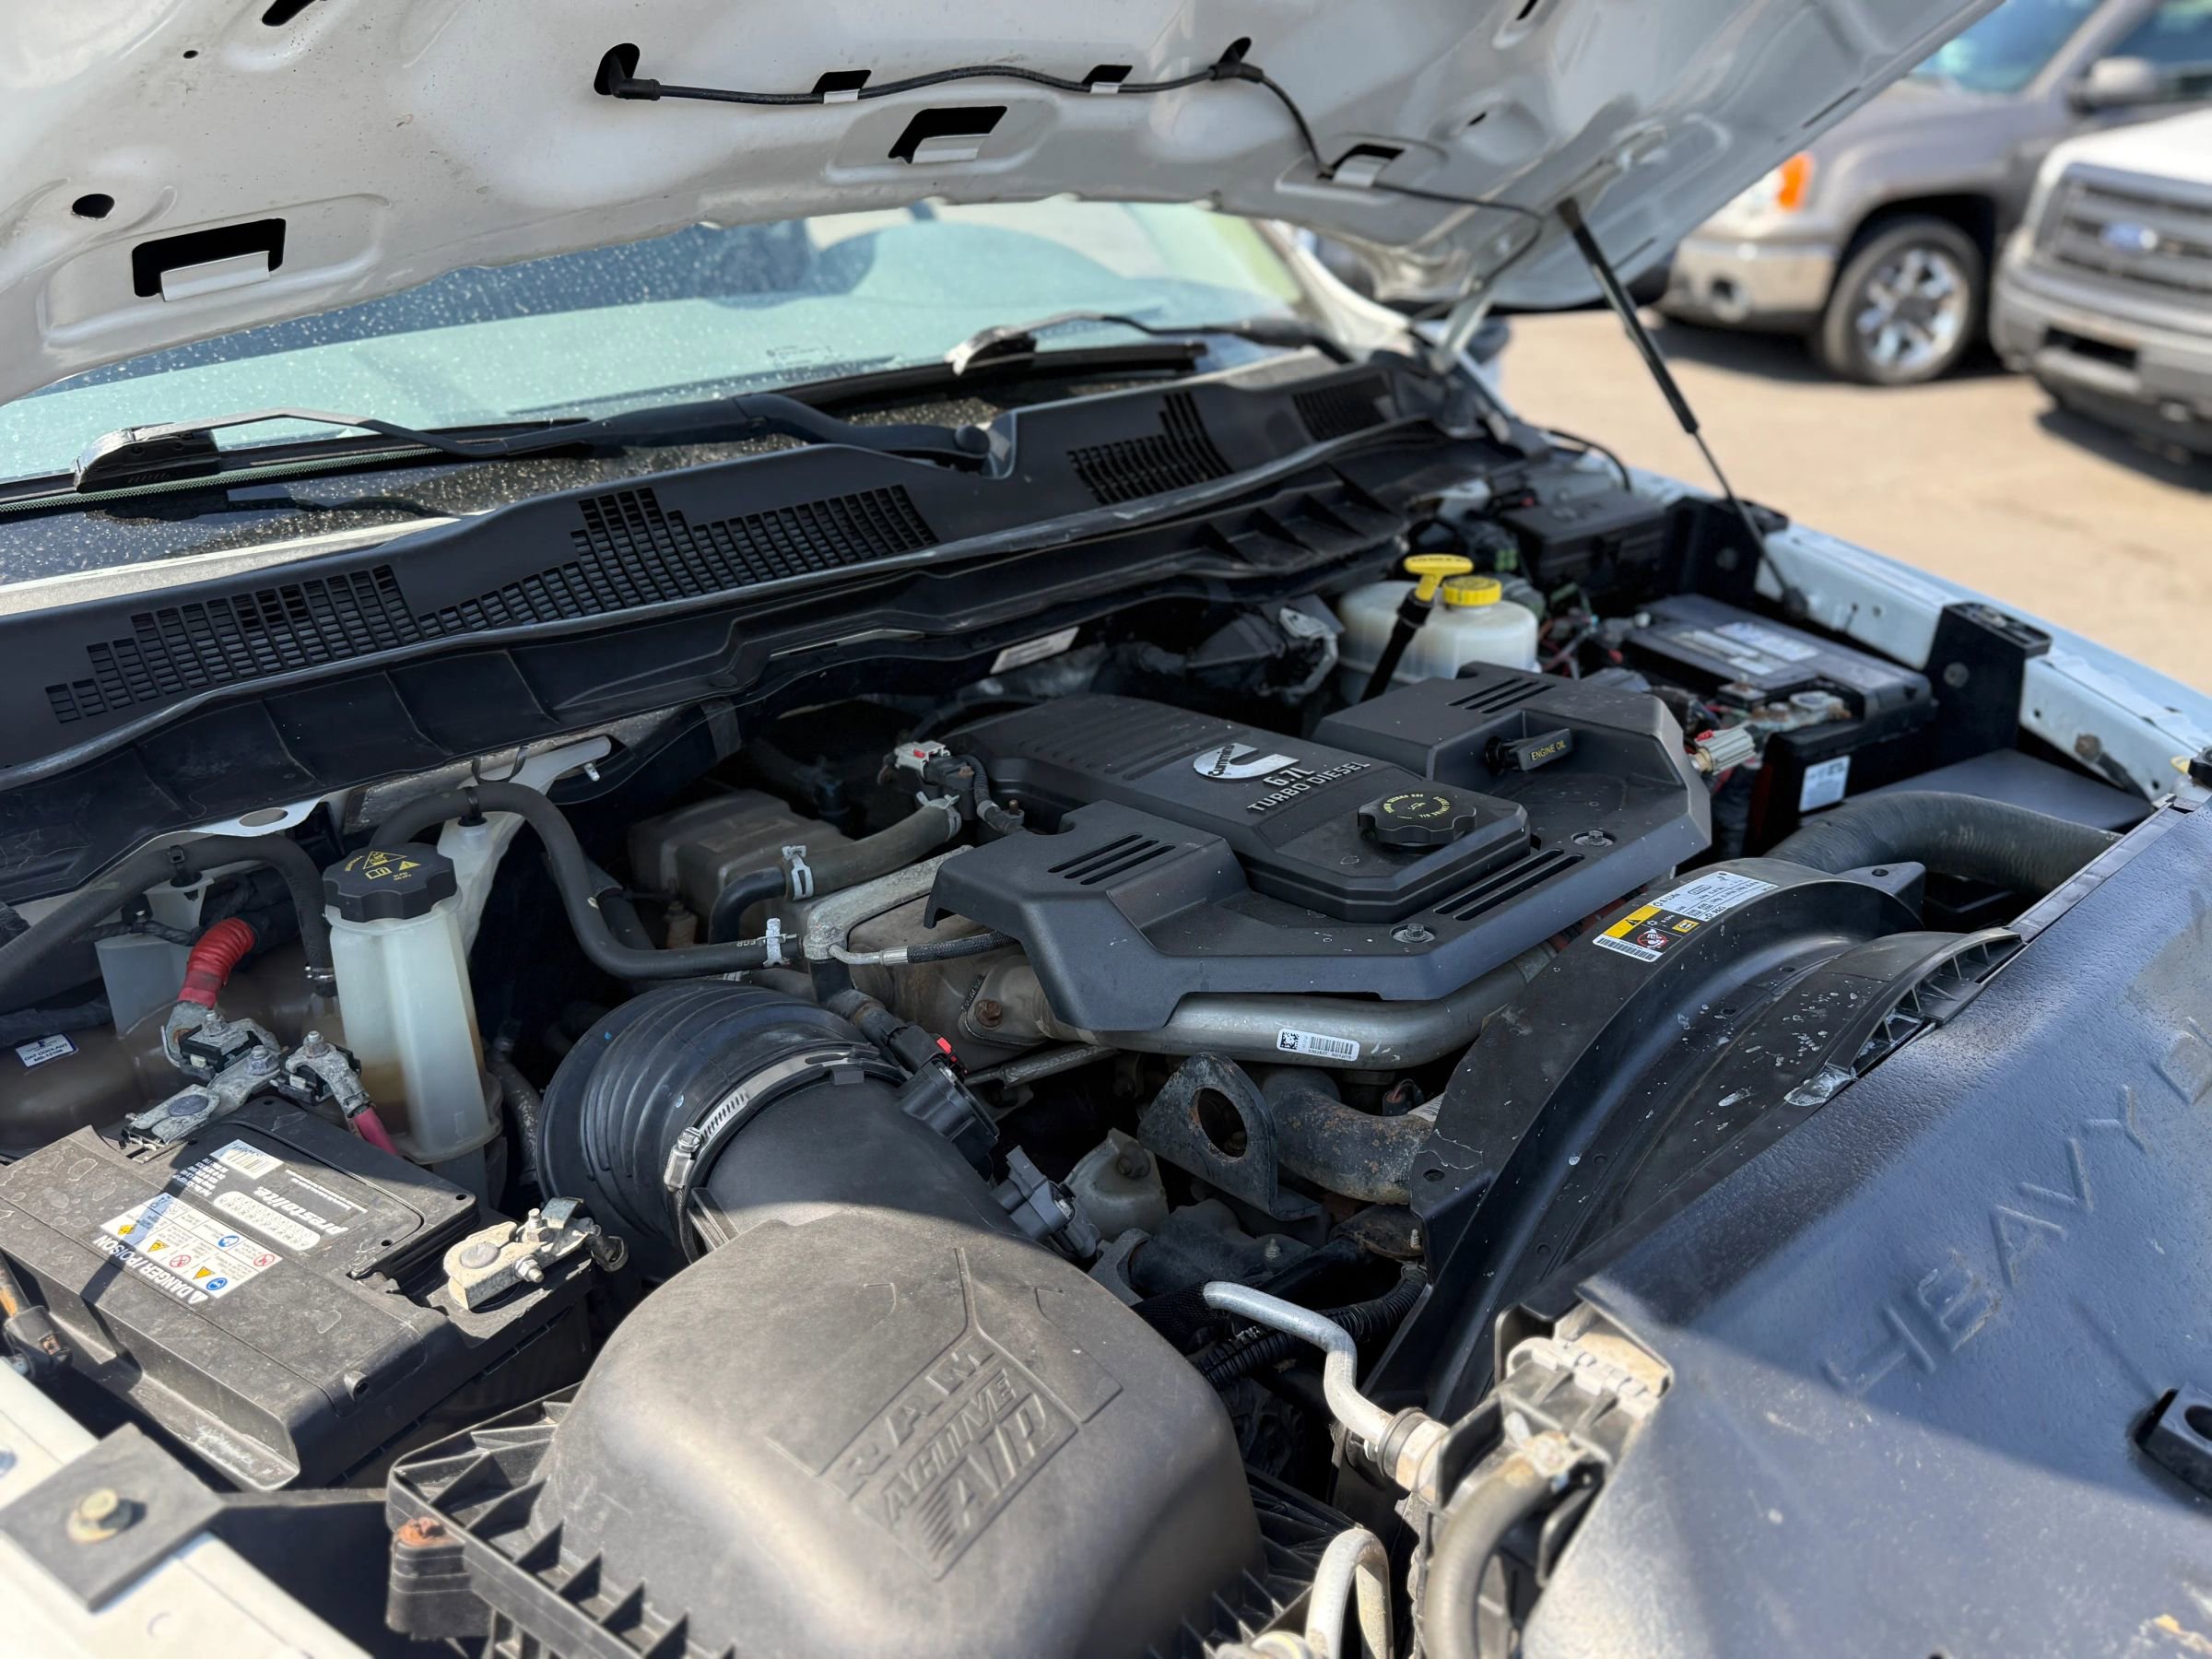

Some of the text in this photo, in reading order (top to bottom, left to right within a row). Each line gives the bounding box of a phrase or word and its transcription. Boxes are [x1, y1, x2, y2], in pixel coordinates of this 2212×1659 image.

[1531, 740, 1566, 760] ENGINE OIL
[1246, 761, 1371, 813] TURBO DIESEL
[1263, 766, 1316, 788] 6.7L
[38, 1043, 67, 1056] COOLANT
[256, 1186, 350, 1236] prestolite
[1820, 1085, 2151, 1396] HEAVY
[841, 1349, 995, 1501] RAM
[882, 1369, 1016, 1524] ACTIVE
